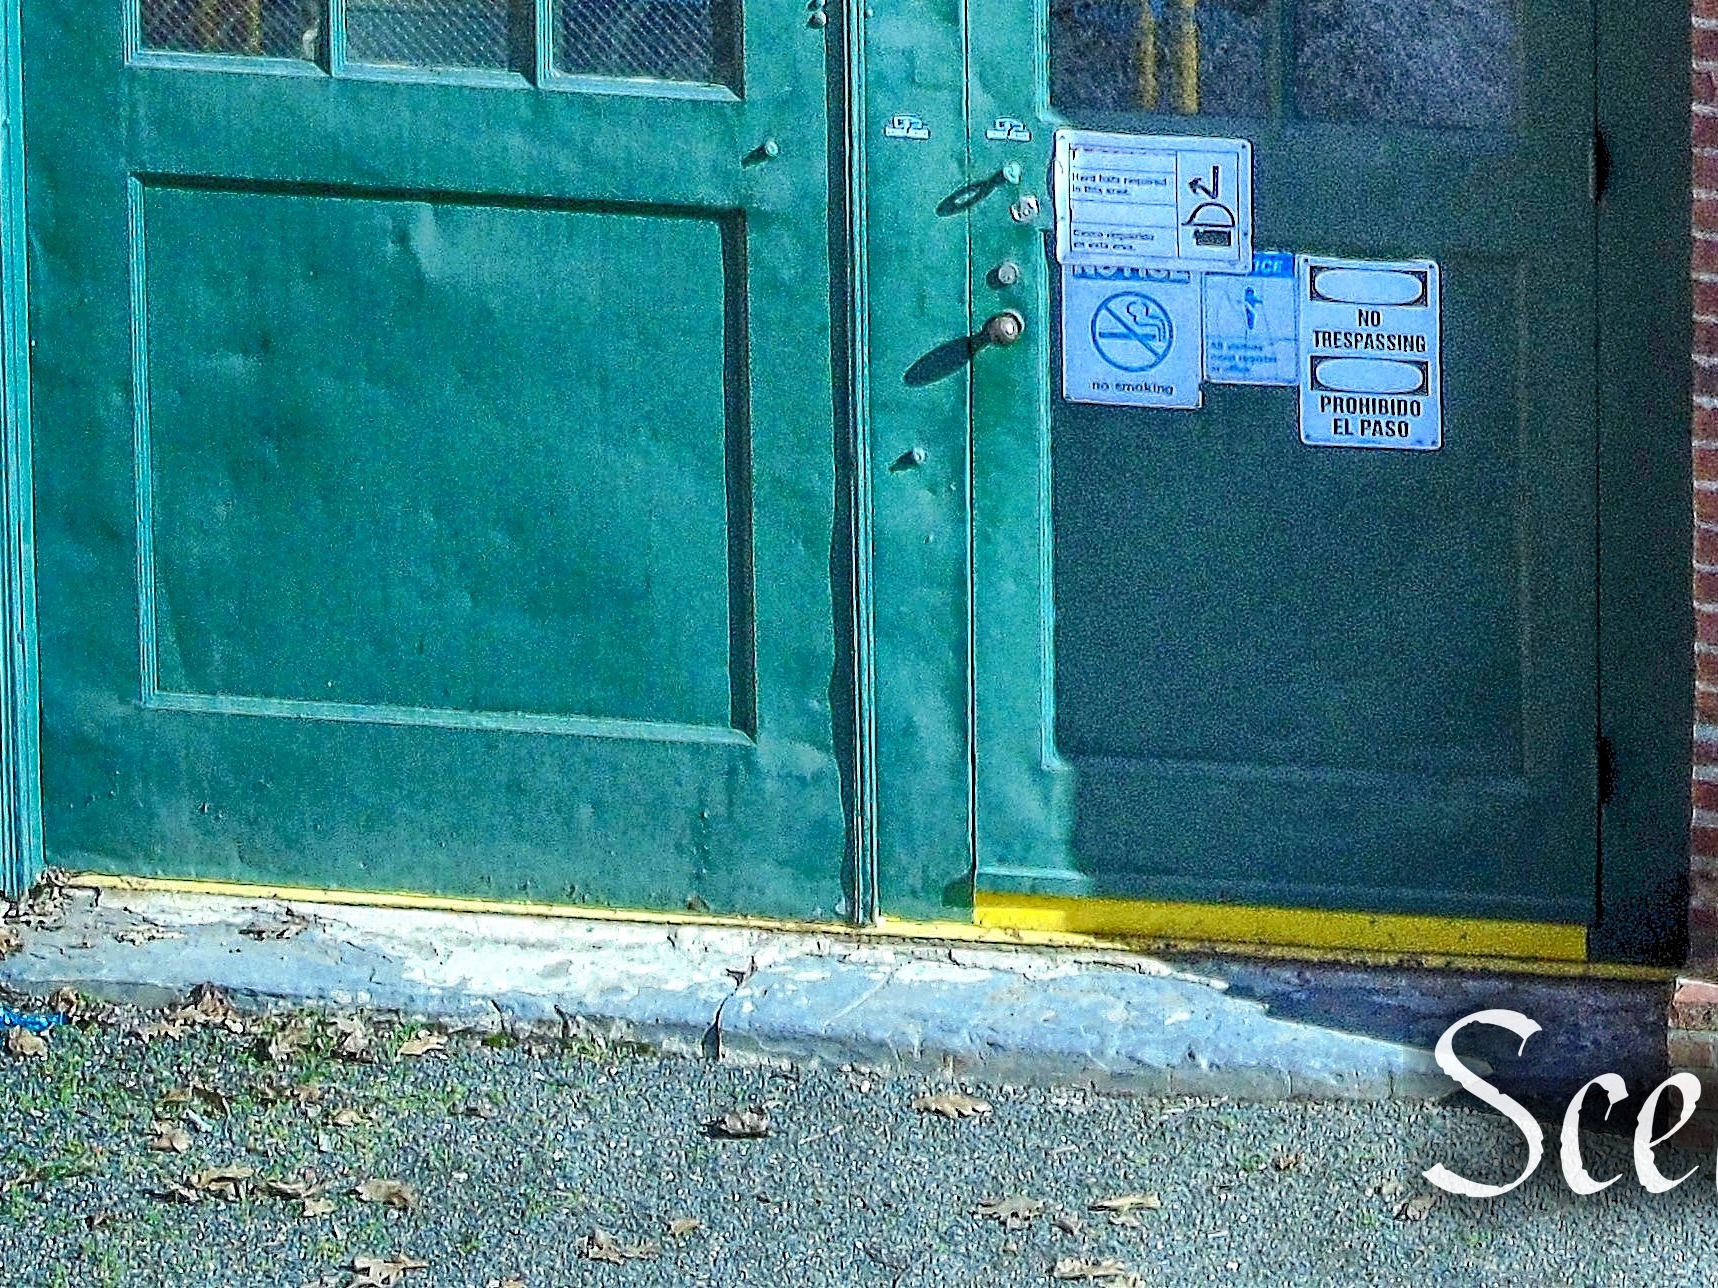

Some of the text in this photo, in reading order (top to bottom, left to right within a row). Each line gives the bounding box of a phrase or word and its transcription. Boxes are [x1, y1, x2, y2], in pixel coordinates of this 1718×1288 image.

[1358, 309, 1381, 327] NO
[1314, 330, 1426, 352] TRESPASSING
[1091, 381, 1174, 396] no smoking
[1320, 395, 1421, 417] PROHIBIDO
[1333, 418, 1409, 438] EL PASO
